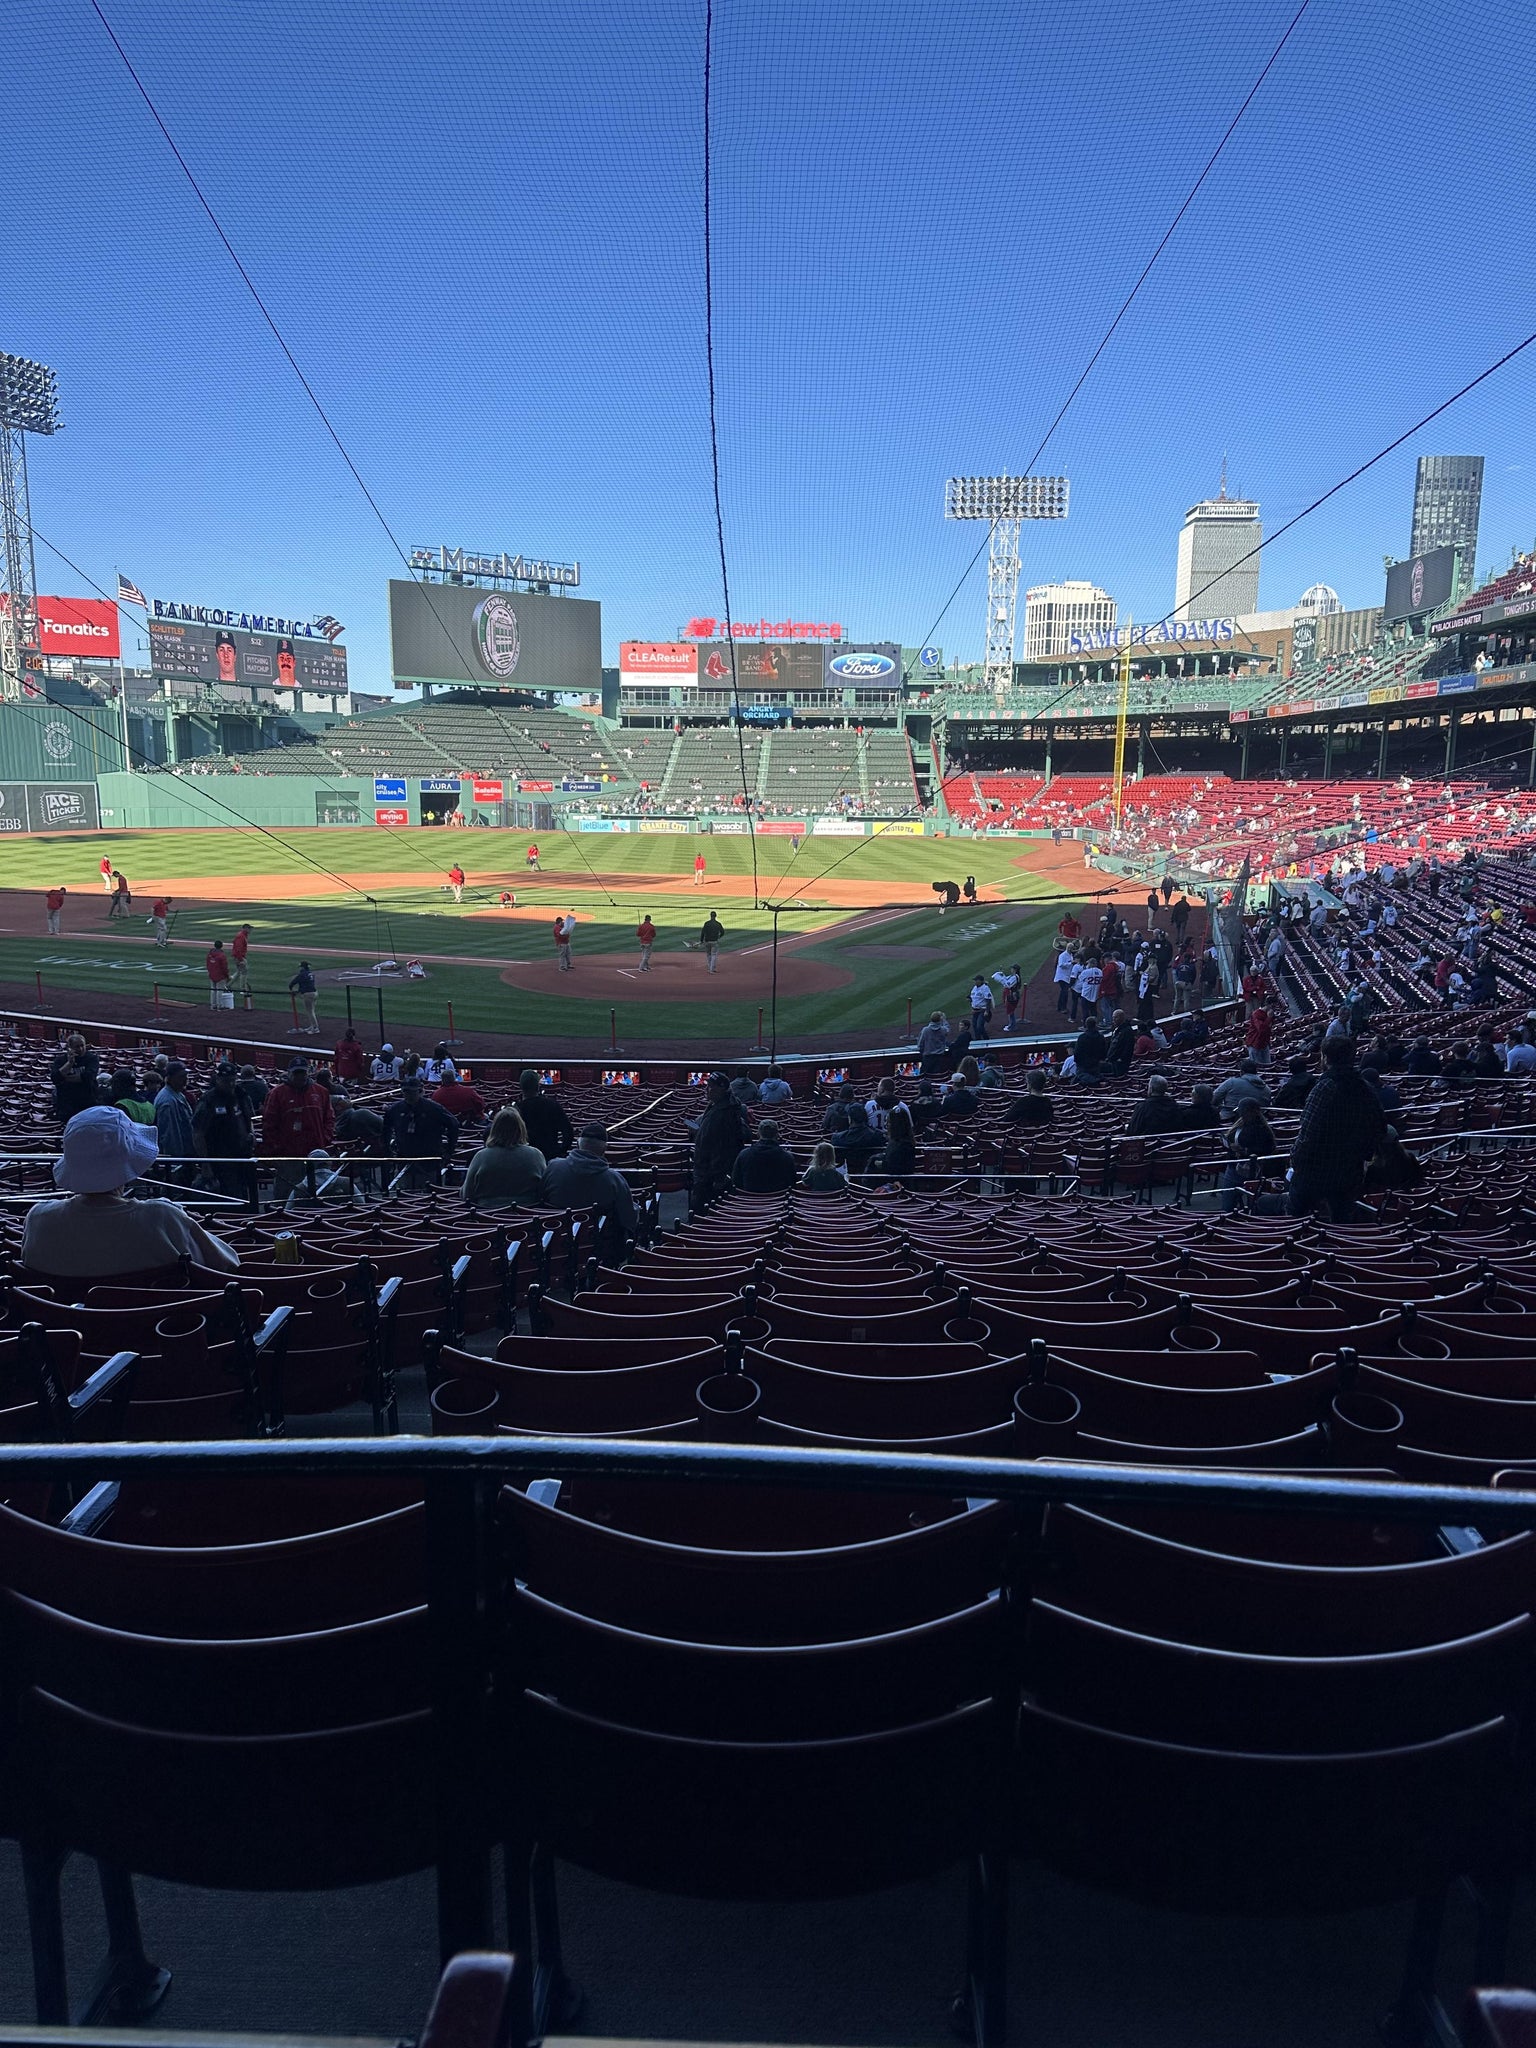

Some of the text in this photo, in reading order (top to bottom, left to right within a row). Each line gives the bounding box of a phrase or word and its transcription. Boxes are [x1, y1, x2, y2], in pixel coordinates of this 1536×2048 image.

[441, 545, 579, 586] MassMutual
[1504, 601, 1530, 617] TONIGHT'S
[153, 599, 313, 638] BANK OF AMERICA
[1437, 614, 1481, 632] BLACK LIVES MATTER
[44, 619, 109, 637] Fanatics
[720, 618, 842, 638] new balance
[1070, 618, 1233, 654] SAMUEL ADAMS
[628, 653, 690, 663] CLEAResult
[842, 656, 883, 675] Ford
[50, 794, 80, 808] ACE
[51, 807, 80, 817] TICKET
[0, 818, 22, 830] EBB
[582, 821, 608, 830] jetBlue
[377, 1063, 393, 1073] 28
